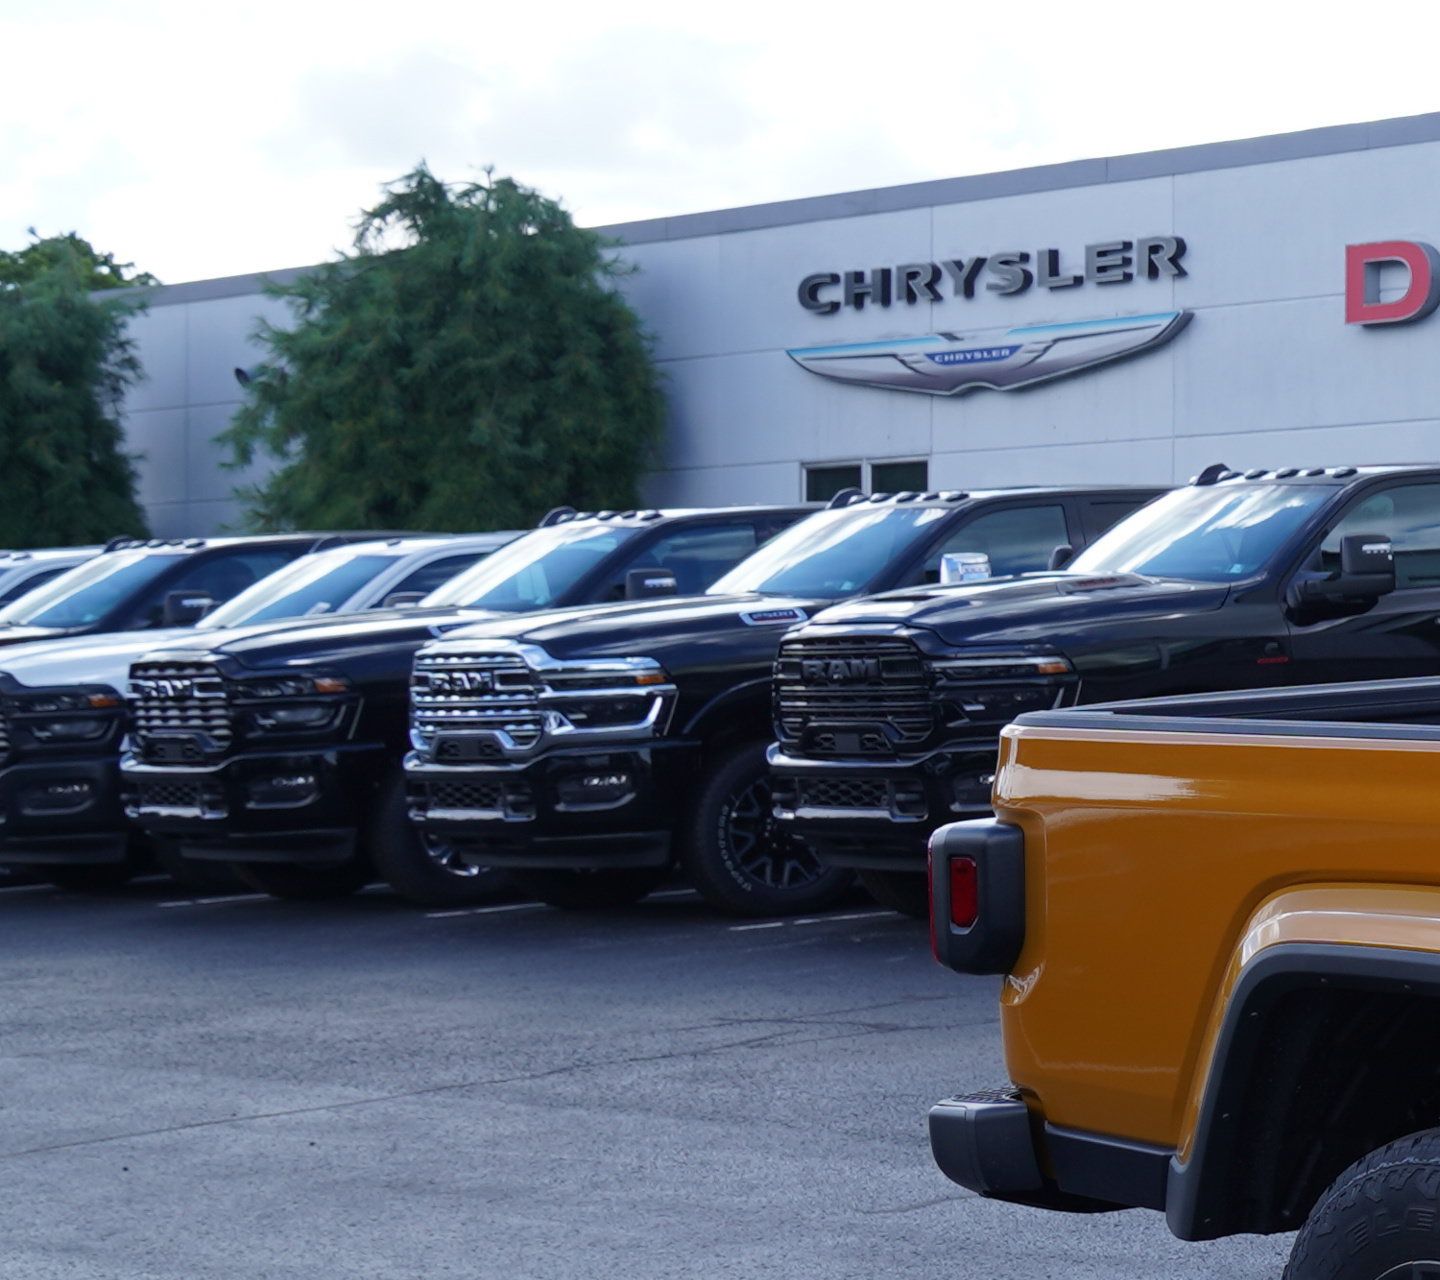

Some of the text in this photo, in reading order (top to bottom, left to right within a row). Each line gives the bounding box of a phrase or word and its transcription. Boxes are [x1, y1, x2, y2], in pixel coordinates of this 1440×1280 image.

[797, 235, 1188, 315] CHRYSLER
[934, 347, 1011, 364] CHRYSLER
[802, 659, 879, 681] RAM
[430, 672, 492, 691] RAM
